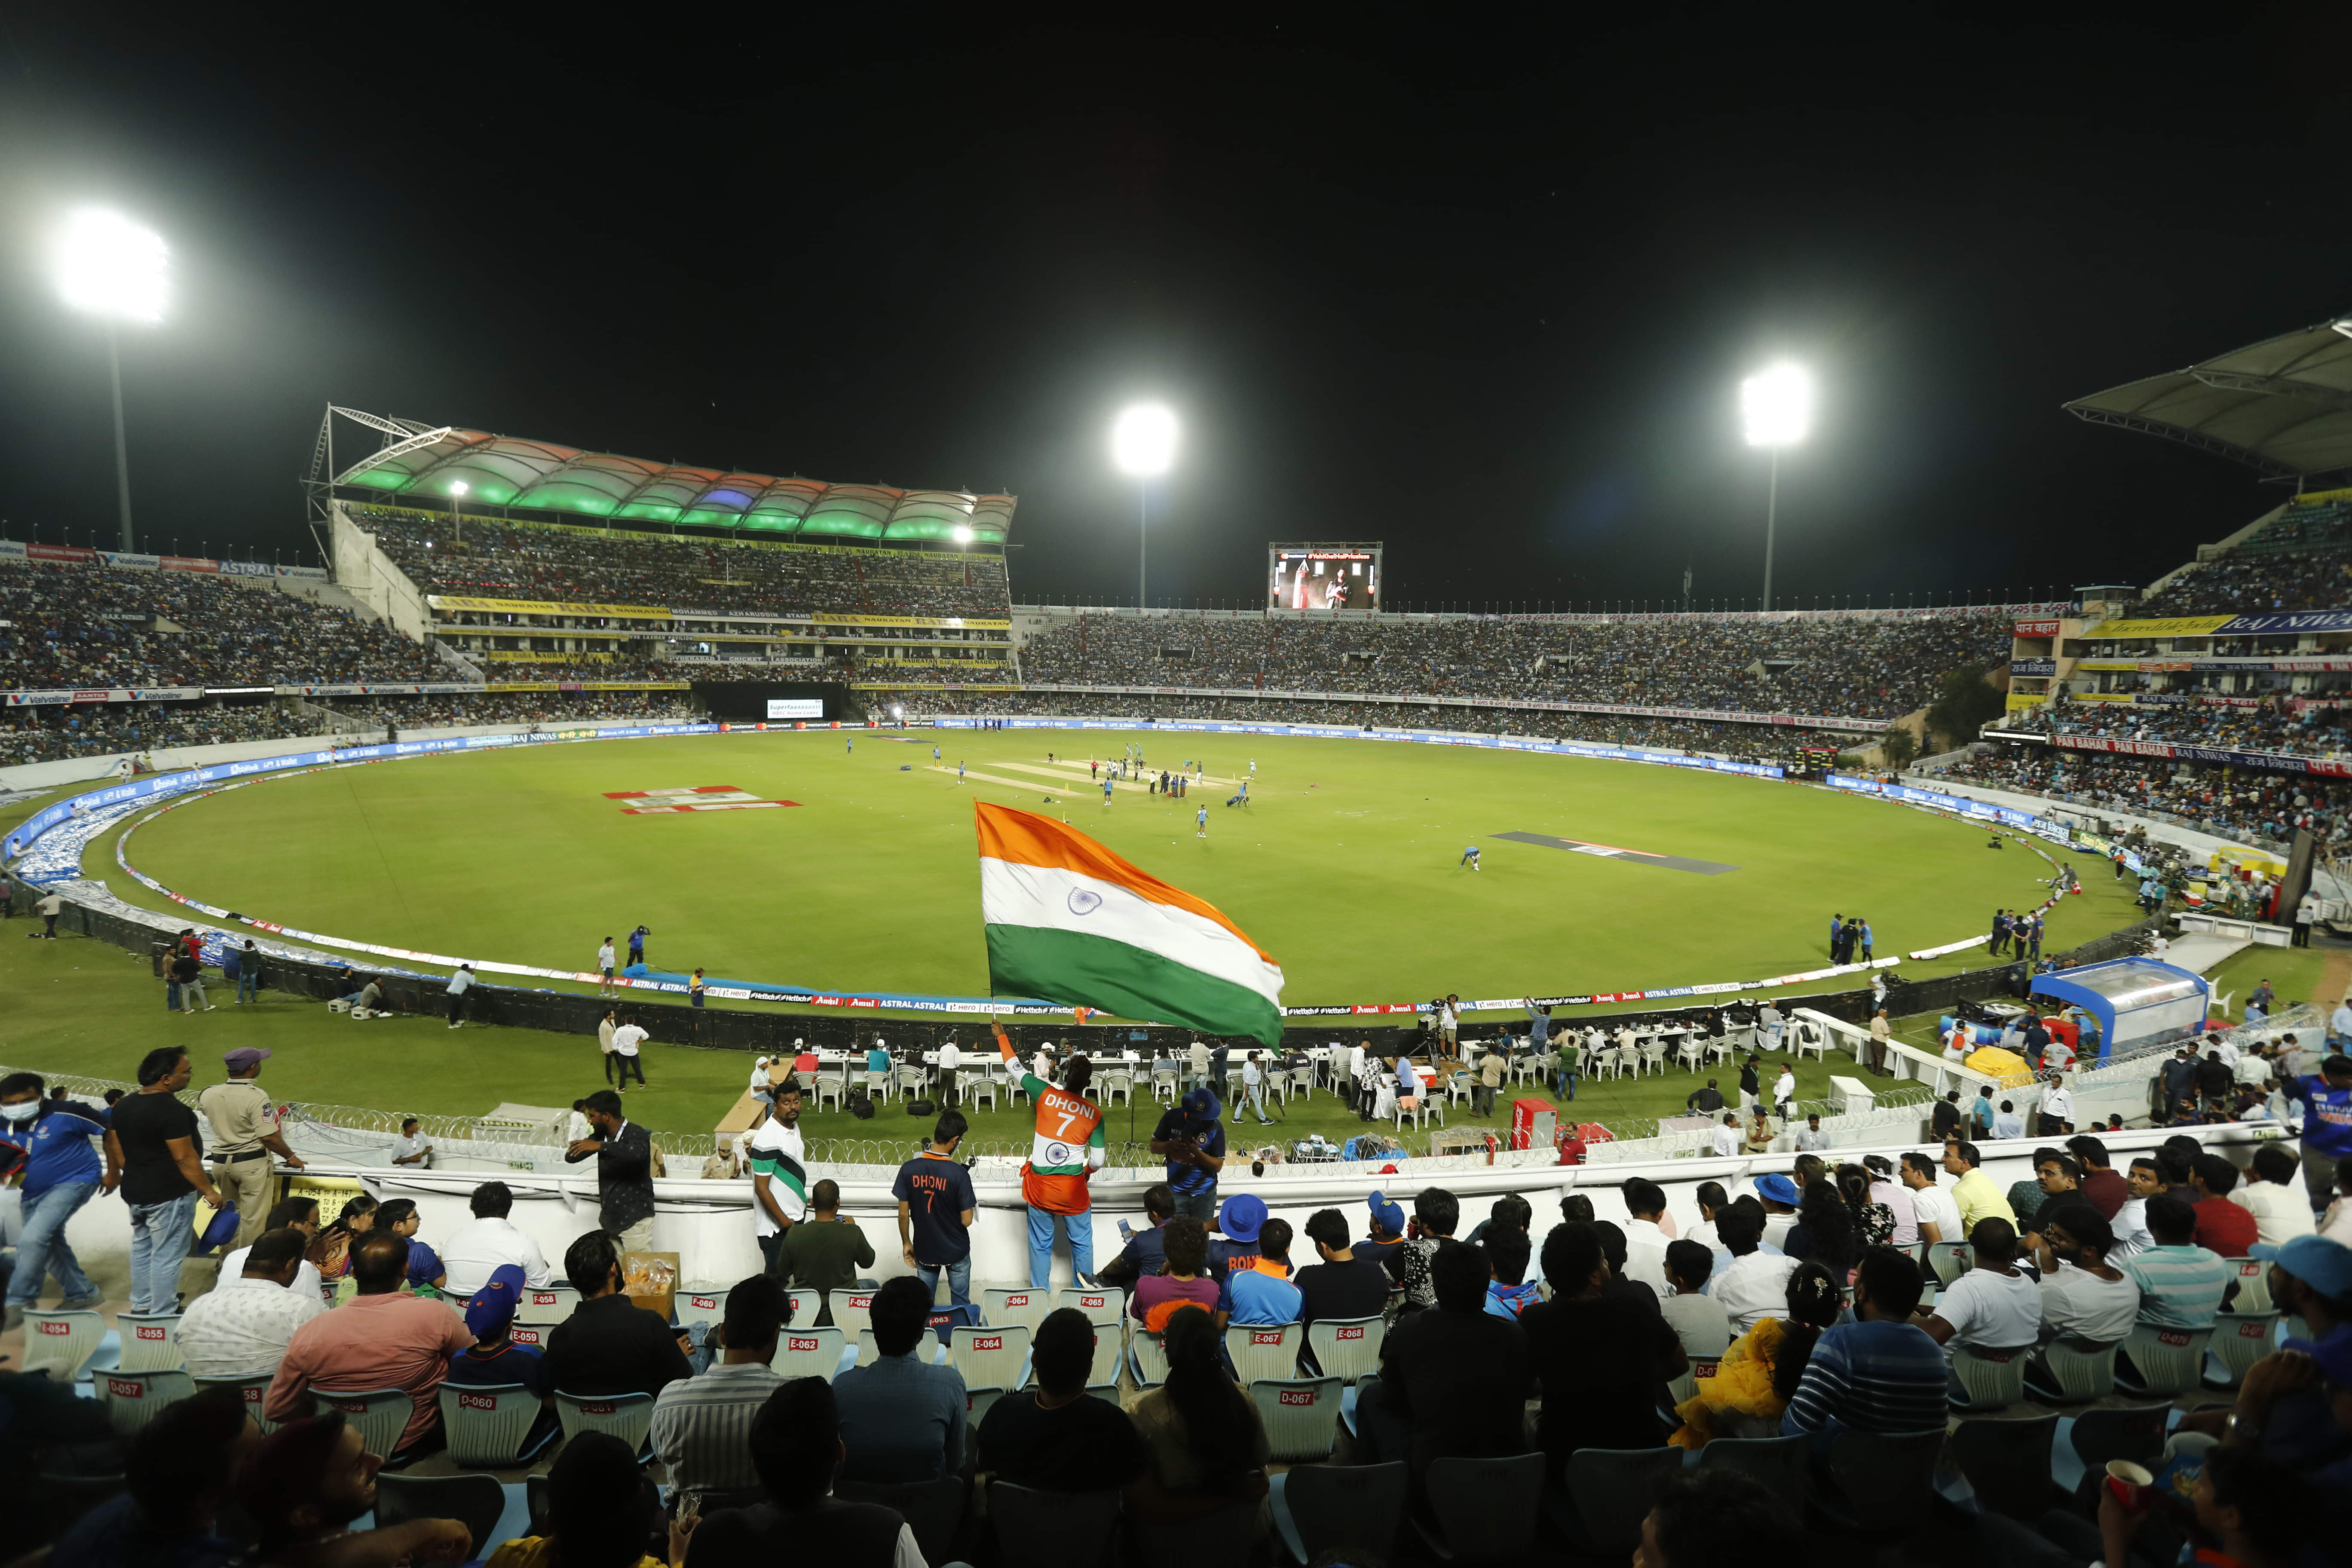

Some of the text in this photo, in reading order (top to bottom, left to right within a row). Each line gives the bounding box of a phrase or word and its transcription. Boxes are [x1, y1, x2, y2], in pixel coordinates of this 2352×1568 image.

[117, 557, 158, 567] Valvoline
[220, 562, 275, 576] ASTRAL
[559, 603, 613, 614] BABA
[2223, 613, 2352, 630] RAJ NIWA
[2016, 624, 2034, 633] पान
[30, 695, 71, 704] Valvoline
[513, 735, 527, 743] RAJ
[530, 733, 557, 741] NIWAS
[2057, 737, 2231, 762] PAN BAHAR PAN BAHAR RAJ NIWAS
[281, 758, 297, 766] Wallet
[581, 974, 600, 983] Amul
[631, 980, 658, 989] ASTRAL
[660, 984, 688, 992] ASTRAL
[816, 996, 839, 1005] Amul
[851, 998, 875, 1007] Amul
[881, 1000, 913, 1008] ASTRAL
[913, 1002, 946, 1010] ASTRAL
[1293, 1007, 1314, 1015] Hettich
[1357, 1005, 1379, 1014] Amul
[1389, 1005, 1411, 1013] Amul
[1540, 998, 1559, 1006] Hettich
[1596, 994, 1615, 1002] Amul
[1622, 992, 1641, 1001] Amul
[1645, 990, 1669, 999] ASTRAL
[1669, 987, 1694, 996] ASTRAL
[1044, 1093, 1095, 1120] DHONI
[1056, 1112, 1076, 1137] 7
[913, 1175, 947, 1191] DHONI
[924, 1190, 935, 1213] 7
[456, 1299, 470, 1308] F-05
[533, 1295, 554, 1304] F-058
[692, 1298, 714, 1308] F-060
[850, 1298, 871, 1307] F-062
[1007, 1296, 1026, 1305] F-064
[1081, 1297, 1102, 1306] F-065
[929, 1316, 949, 1327] F-063
[42, 1323, 67, 1333] E-054
[138, 1328, 164, 1338] E-055
[513, 1331, 537, 1341] E-059
[1255, 1334, 1279, 1342] E-067
[1339, 1329, 1361, 1338] E-068
[790, 1339, 815, 1349] E-062
[975, 1338, 1000, 1348] E-064
[1698, 1366, 1717, 1376] D-0
[110, 1381, 138, 1396] D-057
[461, 1396, 492, 1408] D-060
[1282, 1393, 1311, 1403] D-067
